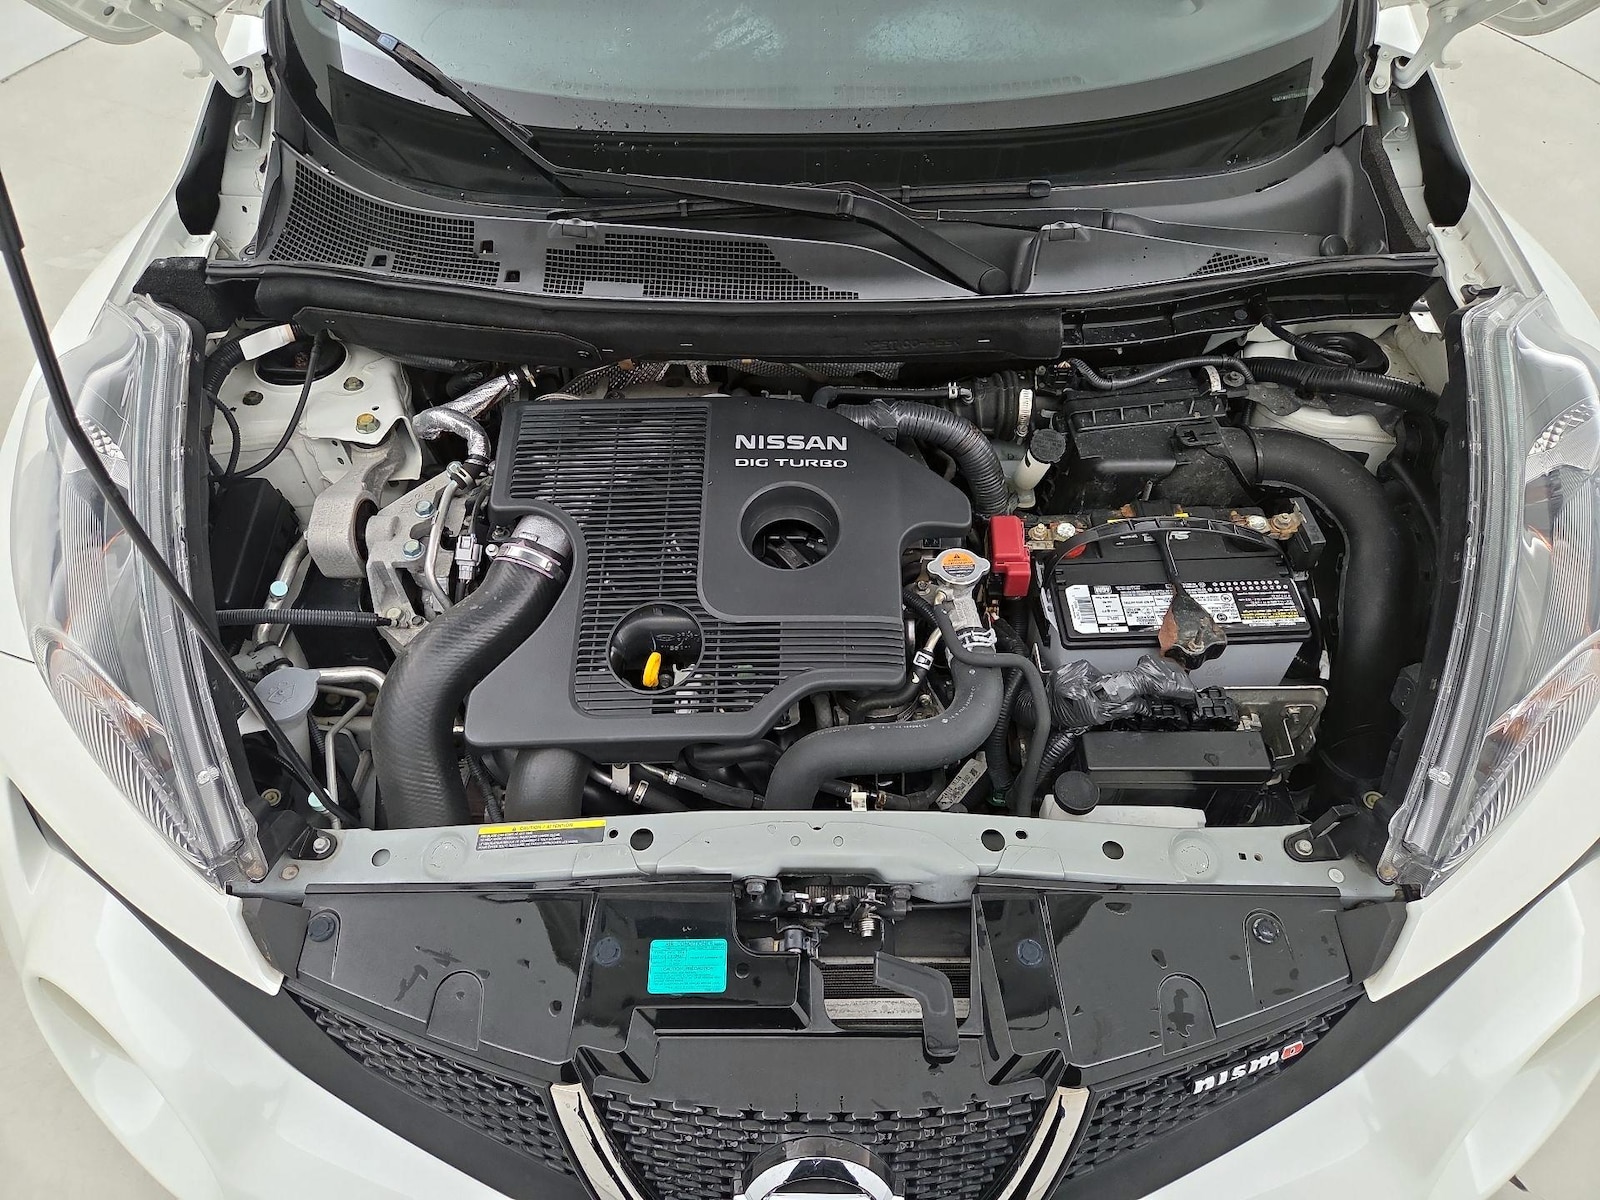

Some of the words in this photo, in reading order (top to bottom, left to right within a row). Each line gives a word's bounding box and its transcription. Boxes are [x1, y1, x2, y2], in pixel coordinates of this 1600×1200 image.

[735, 434, 848, 451] NISSAN
[735, 458, 769, 467] DIG
[774, 458, 848, 468] TURBO
